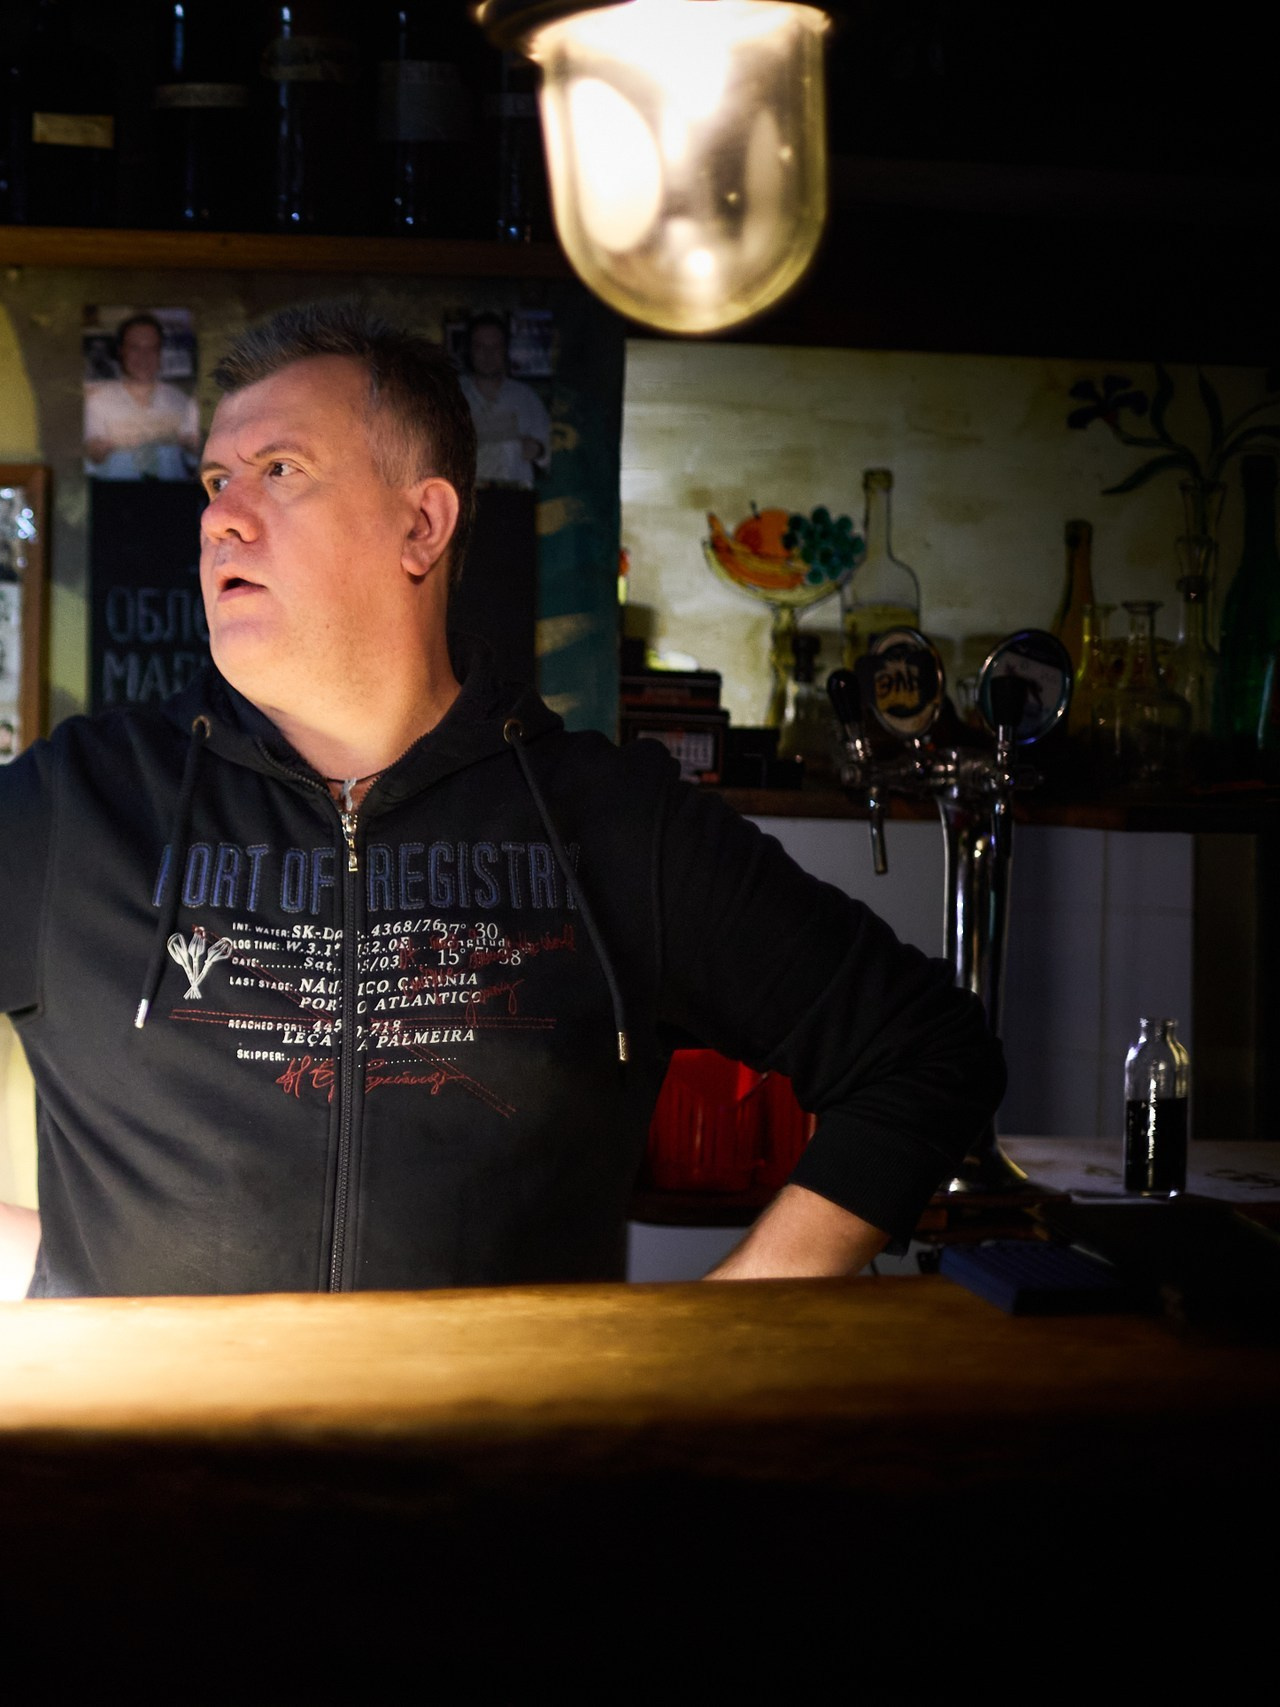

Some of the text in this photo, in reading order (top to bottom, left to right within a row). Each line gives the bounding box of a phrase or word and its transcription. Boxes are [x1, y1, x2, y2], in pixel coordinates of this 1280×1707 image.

[280, 847, 337, 915] OF
[255, 926, 290, 938] WATER:
[475, 922, 498, 940] 30
[232, 939, 251, 950] LOG
[229, 976, 255, 987] LAST
[228, 1020, 273, 1031] REACHED
[376, 1029, 475, 1048] PALMEIRA
[236, 1049, 285, 1061] SKIPPER:
